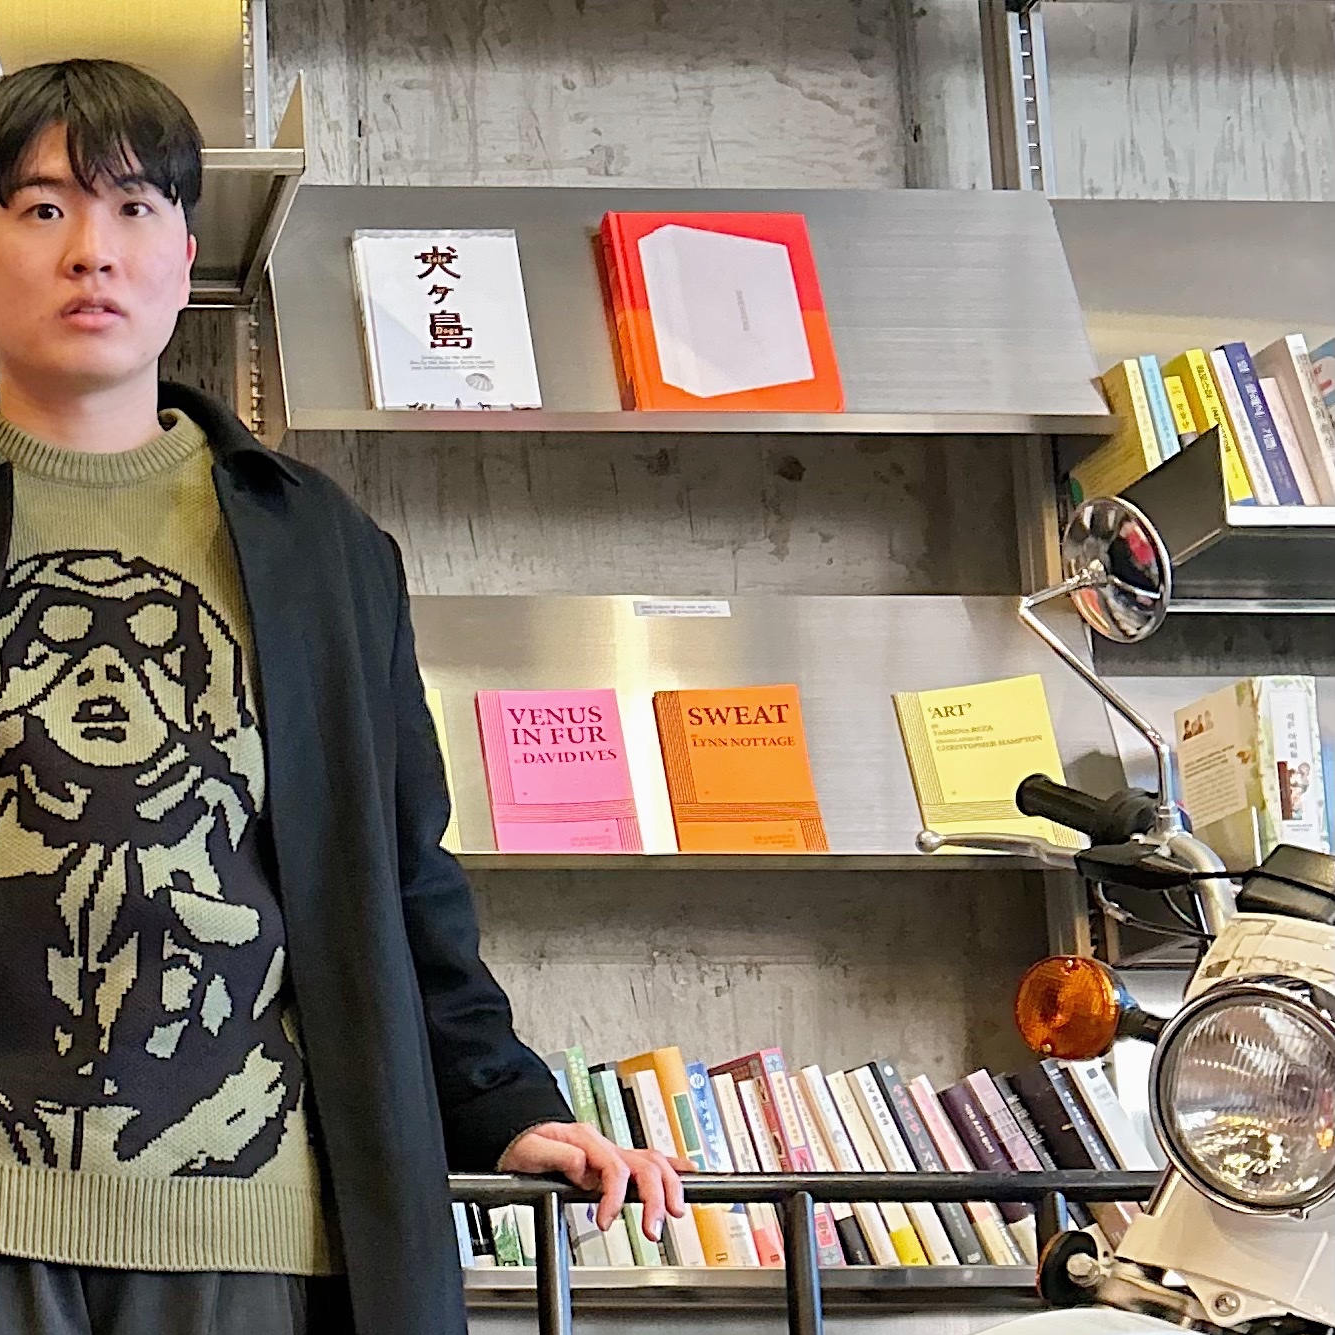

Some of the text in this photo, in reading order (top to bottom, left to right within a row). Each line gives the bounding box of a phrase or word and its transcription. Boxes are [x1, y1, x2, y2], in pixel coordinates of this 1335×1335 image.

[435, 326, 459, 336] Dogs
[508, 706, 603, 726] VENUS
[688, 703, 789, 726] SWEAT
[512, 726, 607, 745] IN FUR
[692, 736, 796, 748] LYNN NOTTAGE
[523, 749, 617, 764] DAVID IVES
